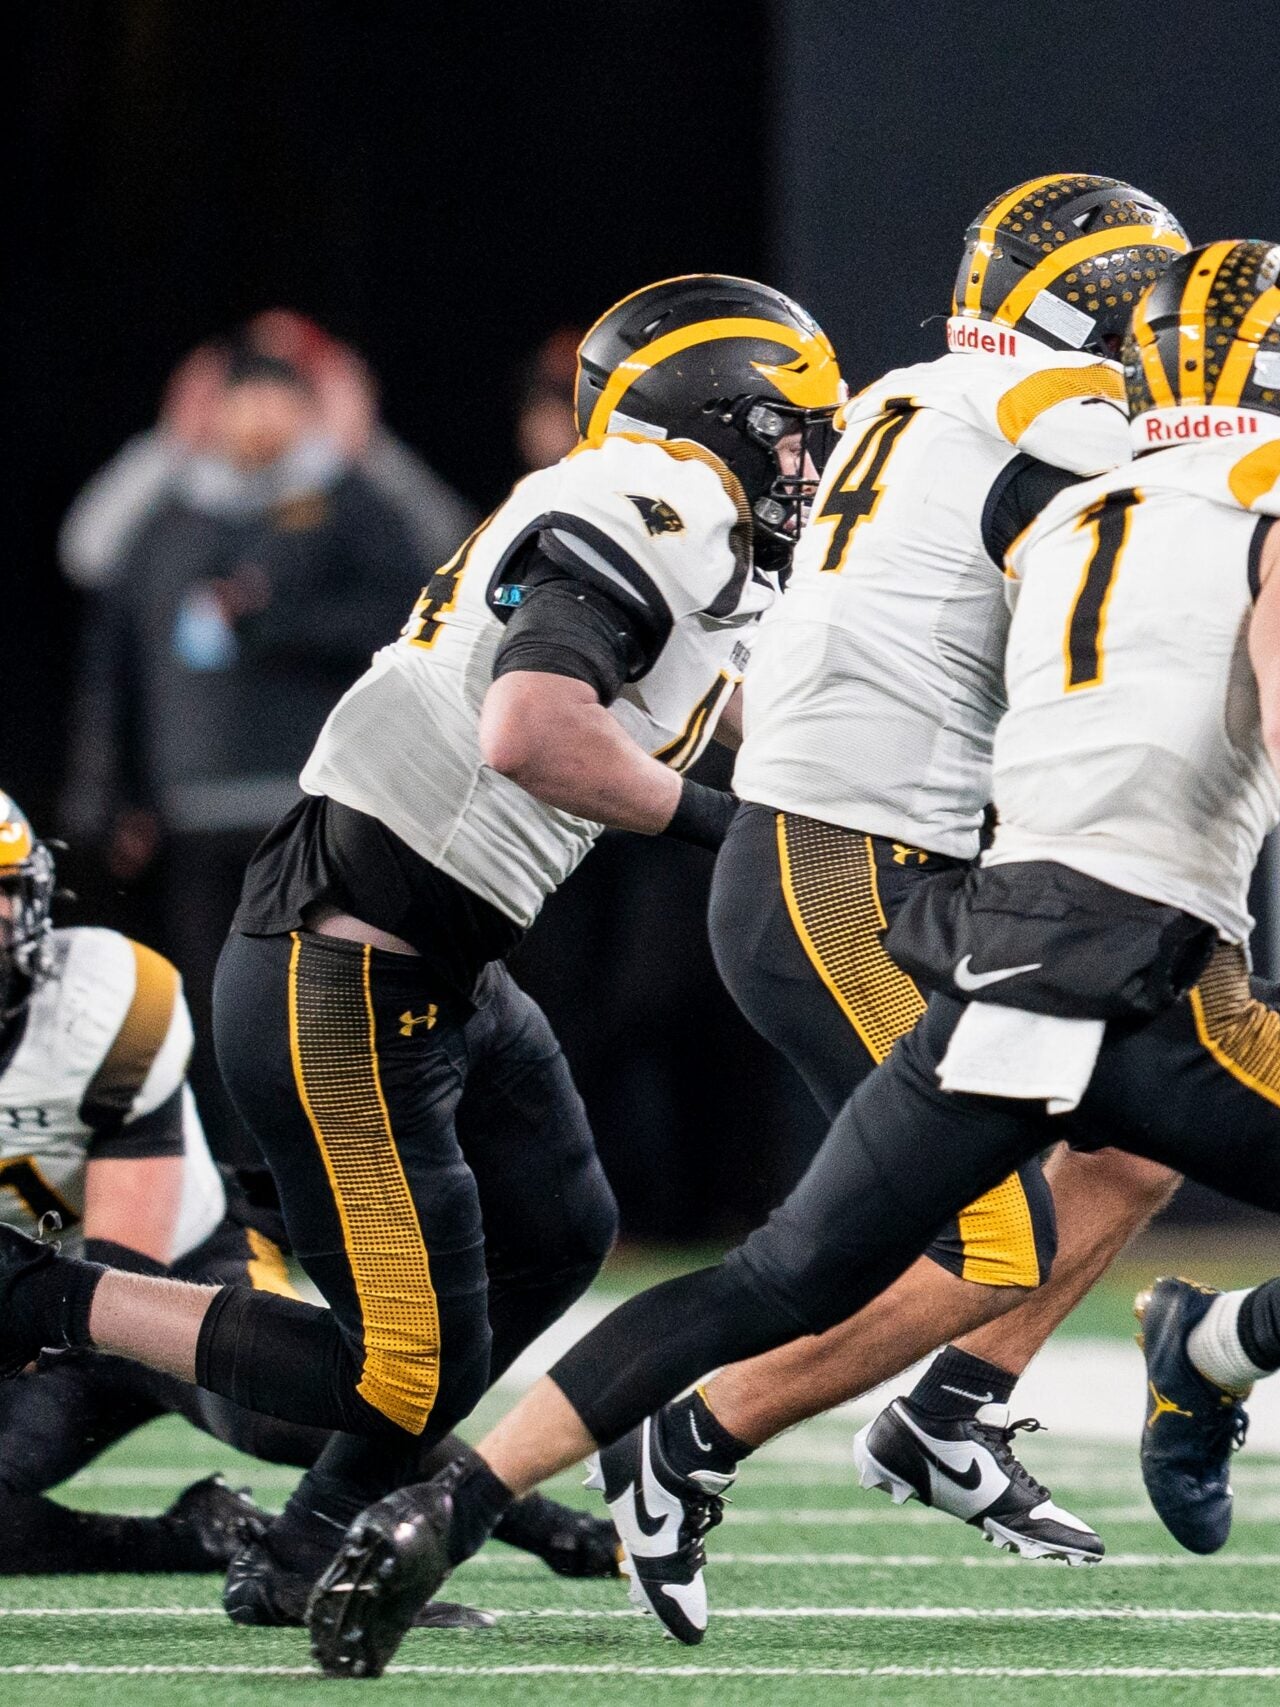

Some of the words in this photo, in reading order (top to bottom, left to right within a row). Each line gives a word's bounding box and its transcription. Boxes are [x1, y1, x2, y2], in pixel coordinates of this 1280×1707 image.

[946, 323, 1016, 357] Riddell
[1146, 415, 1257, 442] Riddell
[814, 396, 922, 574] 4
[1064, 487, 1145, 692] 1
